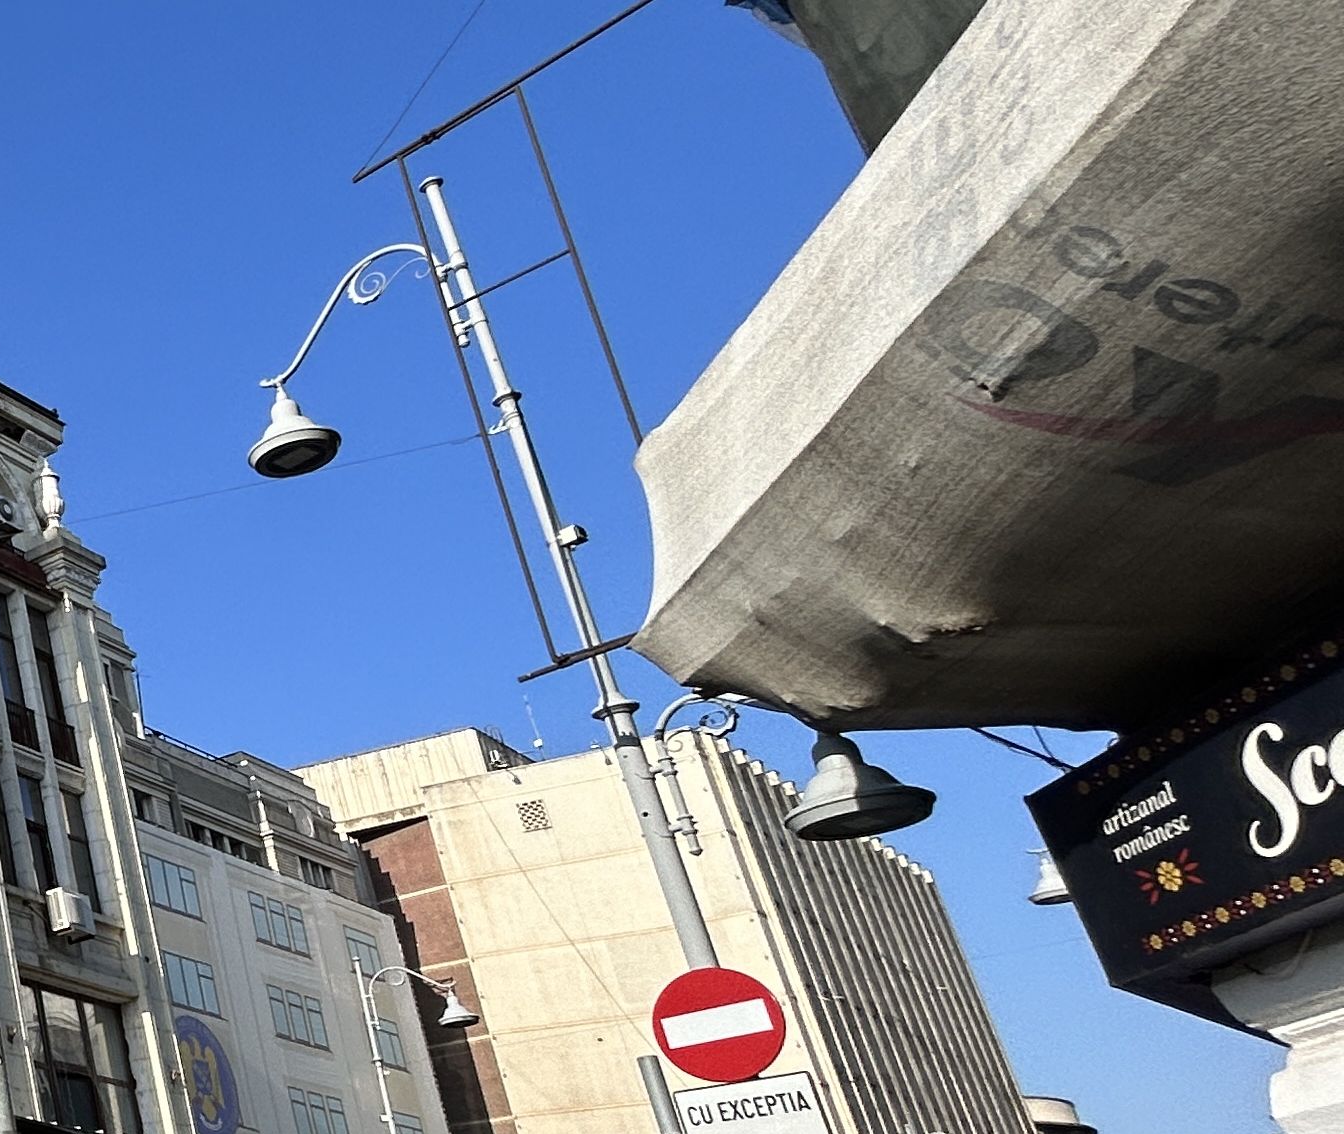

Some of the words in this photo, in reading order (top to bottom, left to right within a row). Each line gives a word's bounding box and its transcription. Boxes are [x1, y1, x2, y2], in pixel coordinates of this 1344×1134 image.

[1102, 780, 1178, 835] artizanal
[1113, 815, 1191, 863] românesc
[687, 1104, 713, 1126] CU
[717, 1090, 811, 1121] EXCEPTIA
